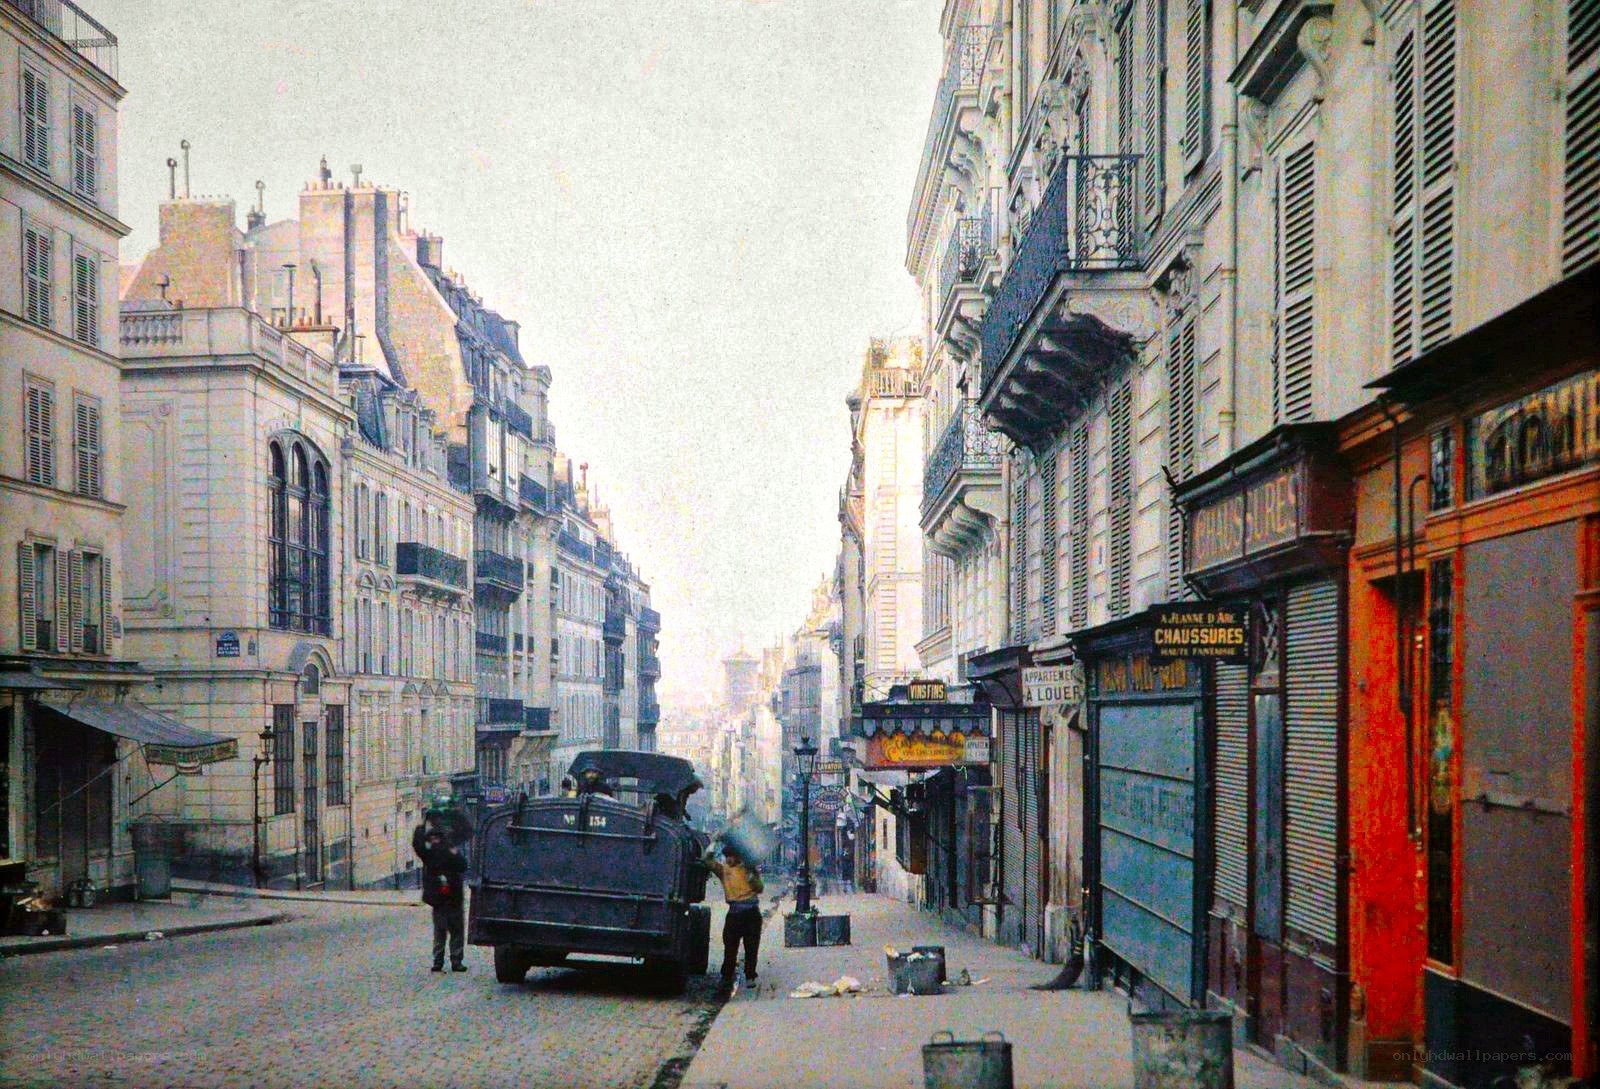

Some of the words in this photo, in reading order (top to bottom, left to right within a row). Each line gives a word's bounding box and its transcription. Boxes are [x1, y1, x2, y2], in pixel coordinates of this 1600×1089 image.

[1154, 627, 1243, 644] CHAUSSURES
[910, 684, 926, 699] VINS
[927, 684, 944, 699] FINS
[1037, 684, 1081, 702] LOUER
